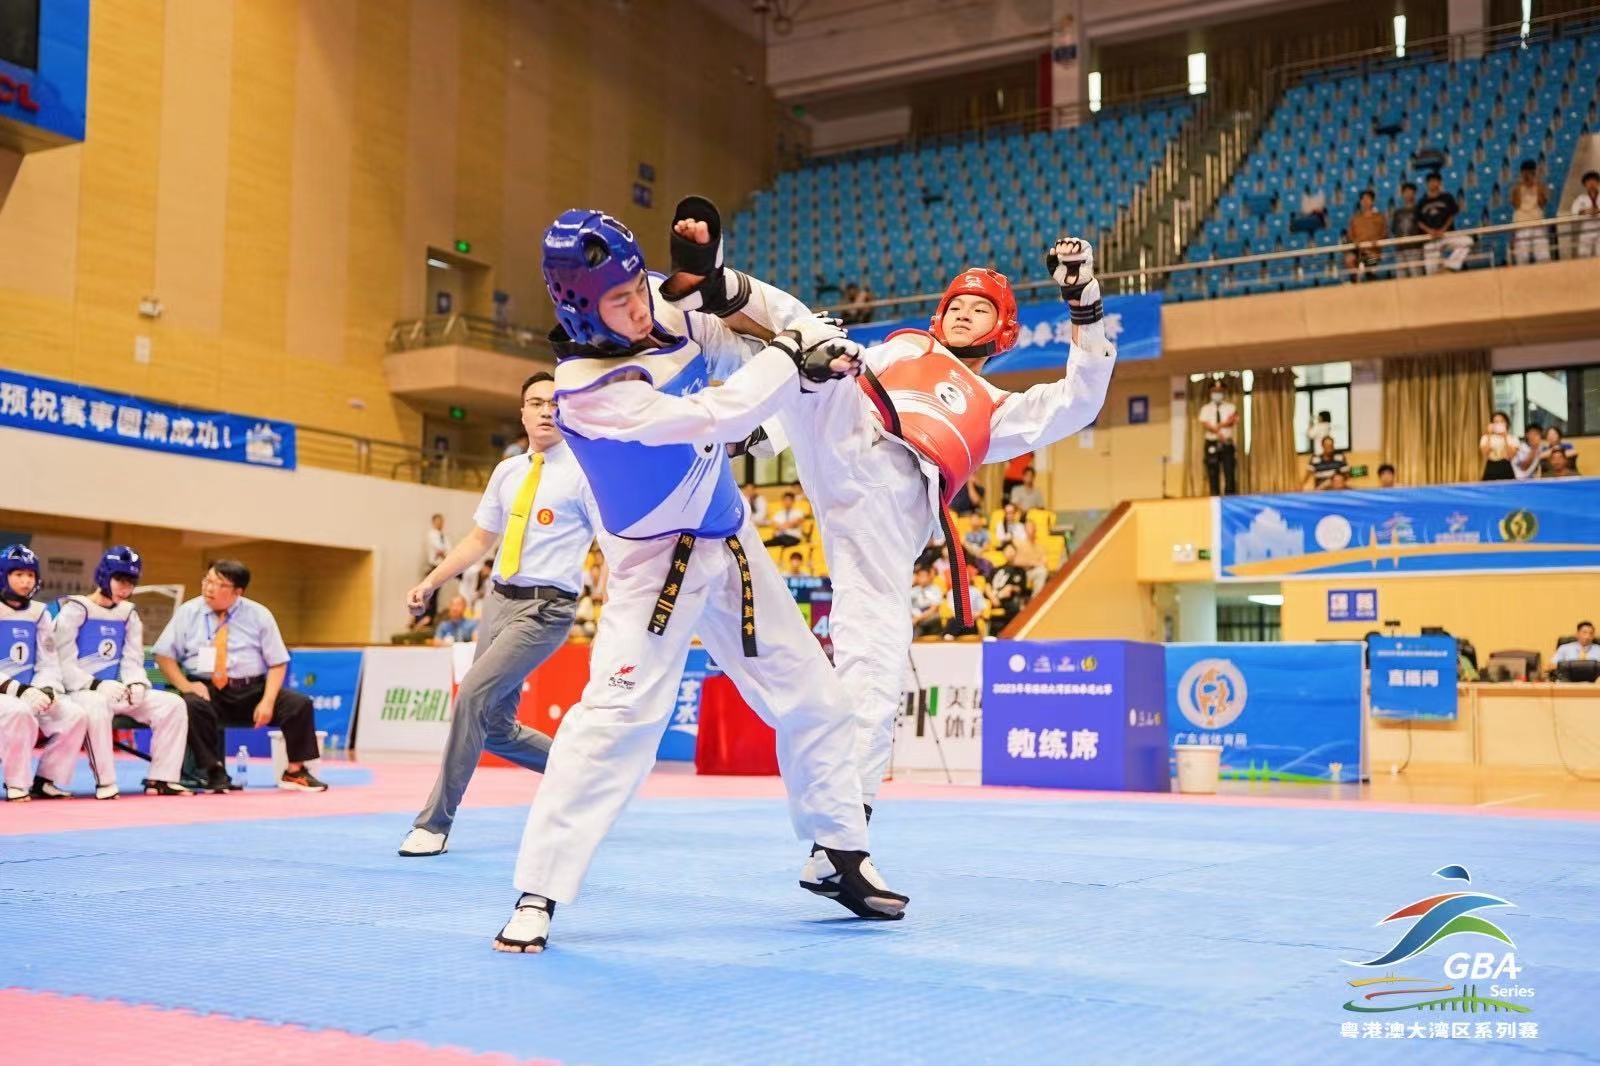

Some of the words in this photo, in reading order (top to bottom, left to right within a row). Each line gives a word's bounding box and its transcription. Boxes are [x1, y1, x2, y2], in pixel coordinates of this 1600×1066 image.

[540, 509, 551, 524] 6
[103, 642, 113, 657] 2
[1007, 727, 1099, 760] 教练席
